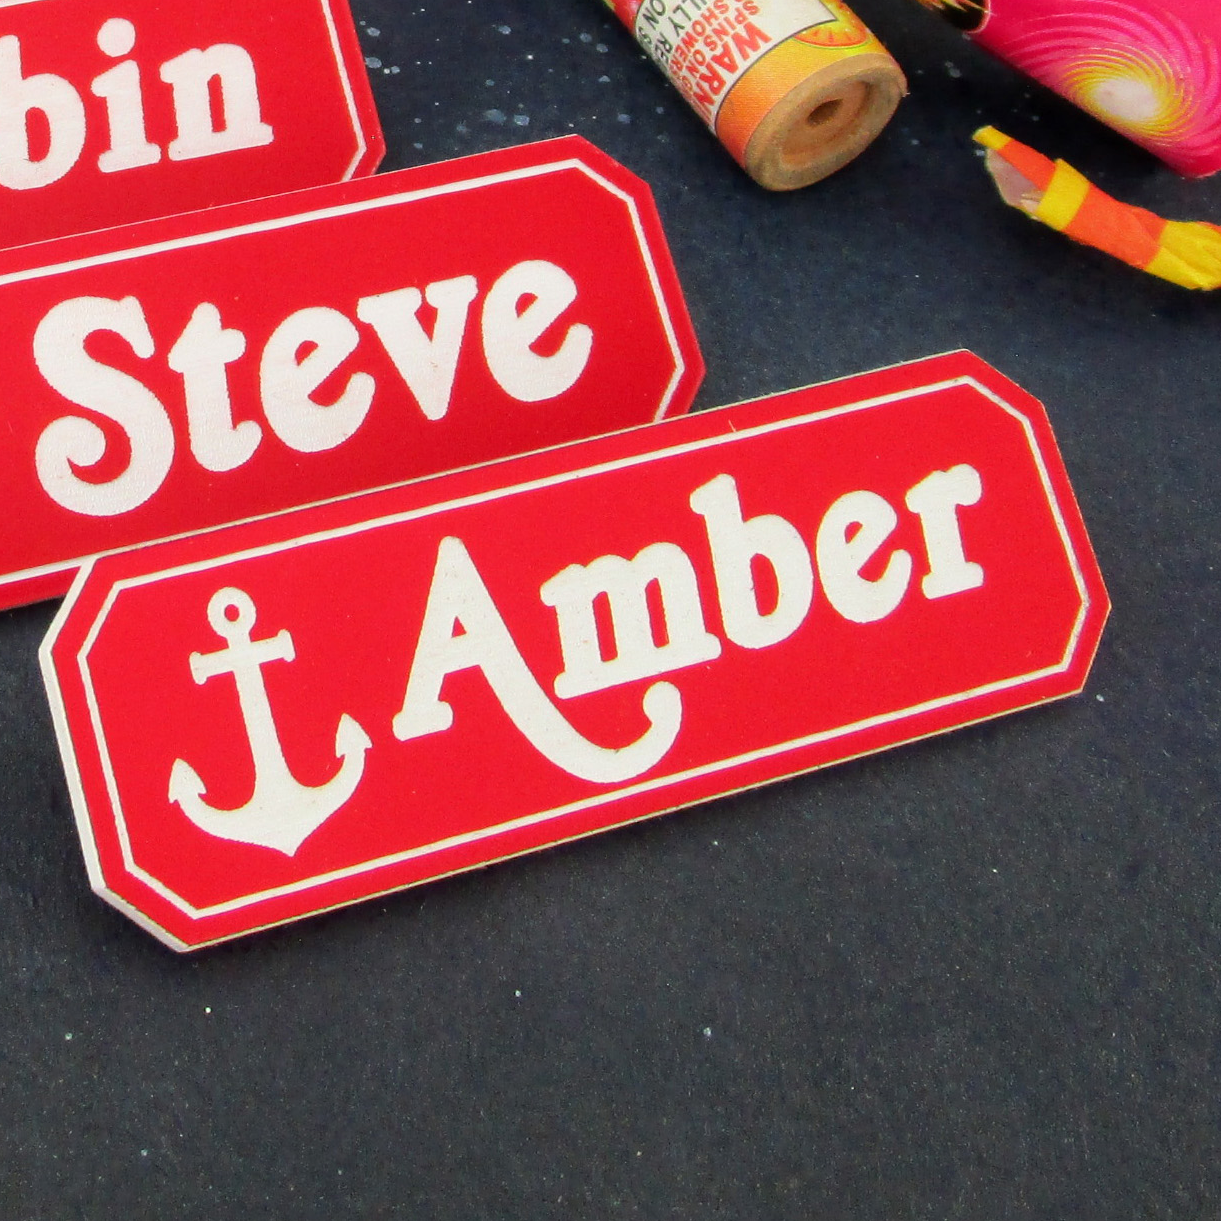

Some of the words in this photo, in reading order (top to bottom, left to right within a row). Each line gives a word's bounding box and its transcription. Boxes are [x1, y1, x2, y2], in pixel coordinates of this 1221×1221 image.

[684, 49, 707, 79] ON
[684, 21, 774, 119] WARN
[703, 0, 761, 52] SPINS
[33, 259, 594, 517] Steve
[391, 463, 985, 785] Amber
